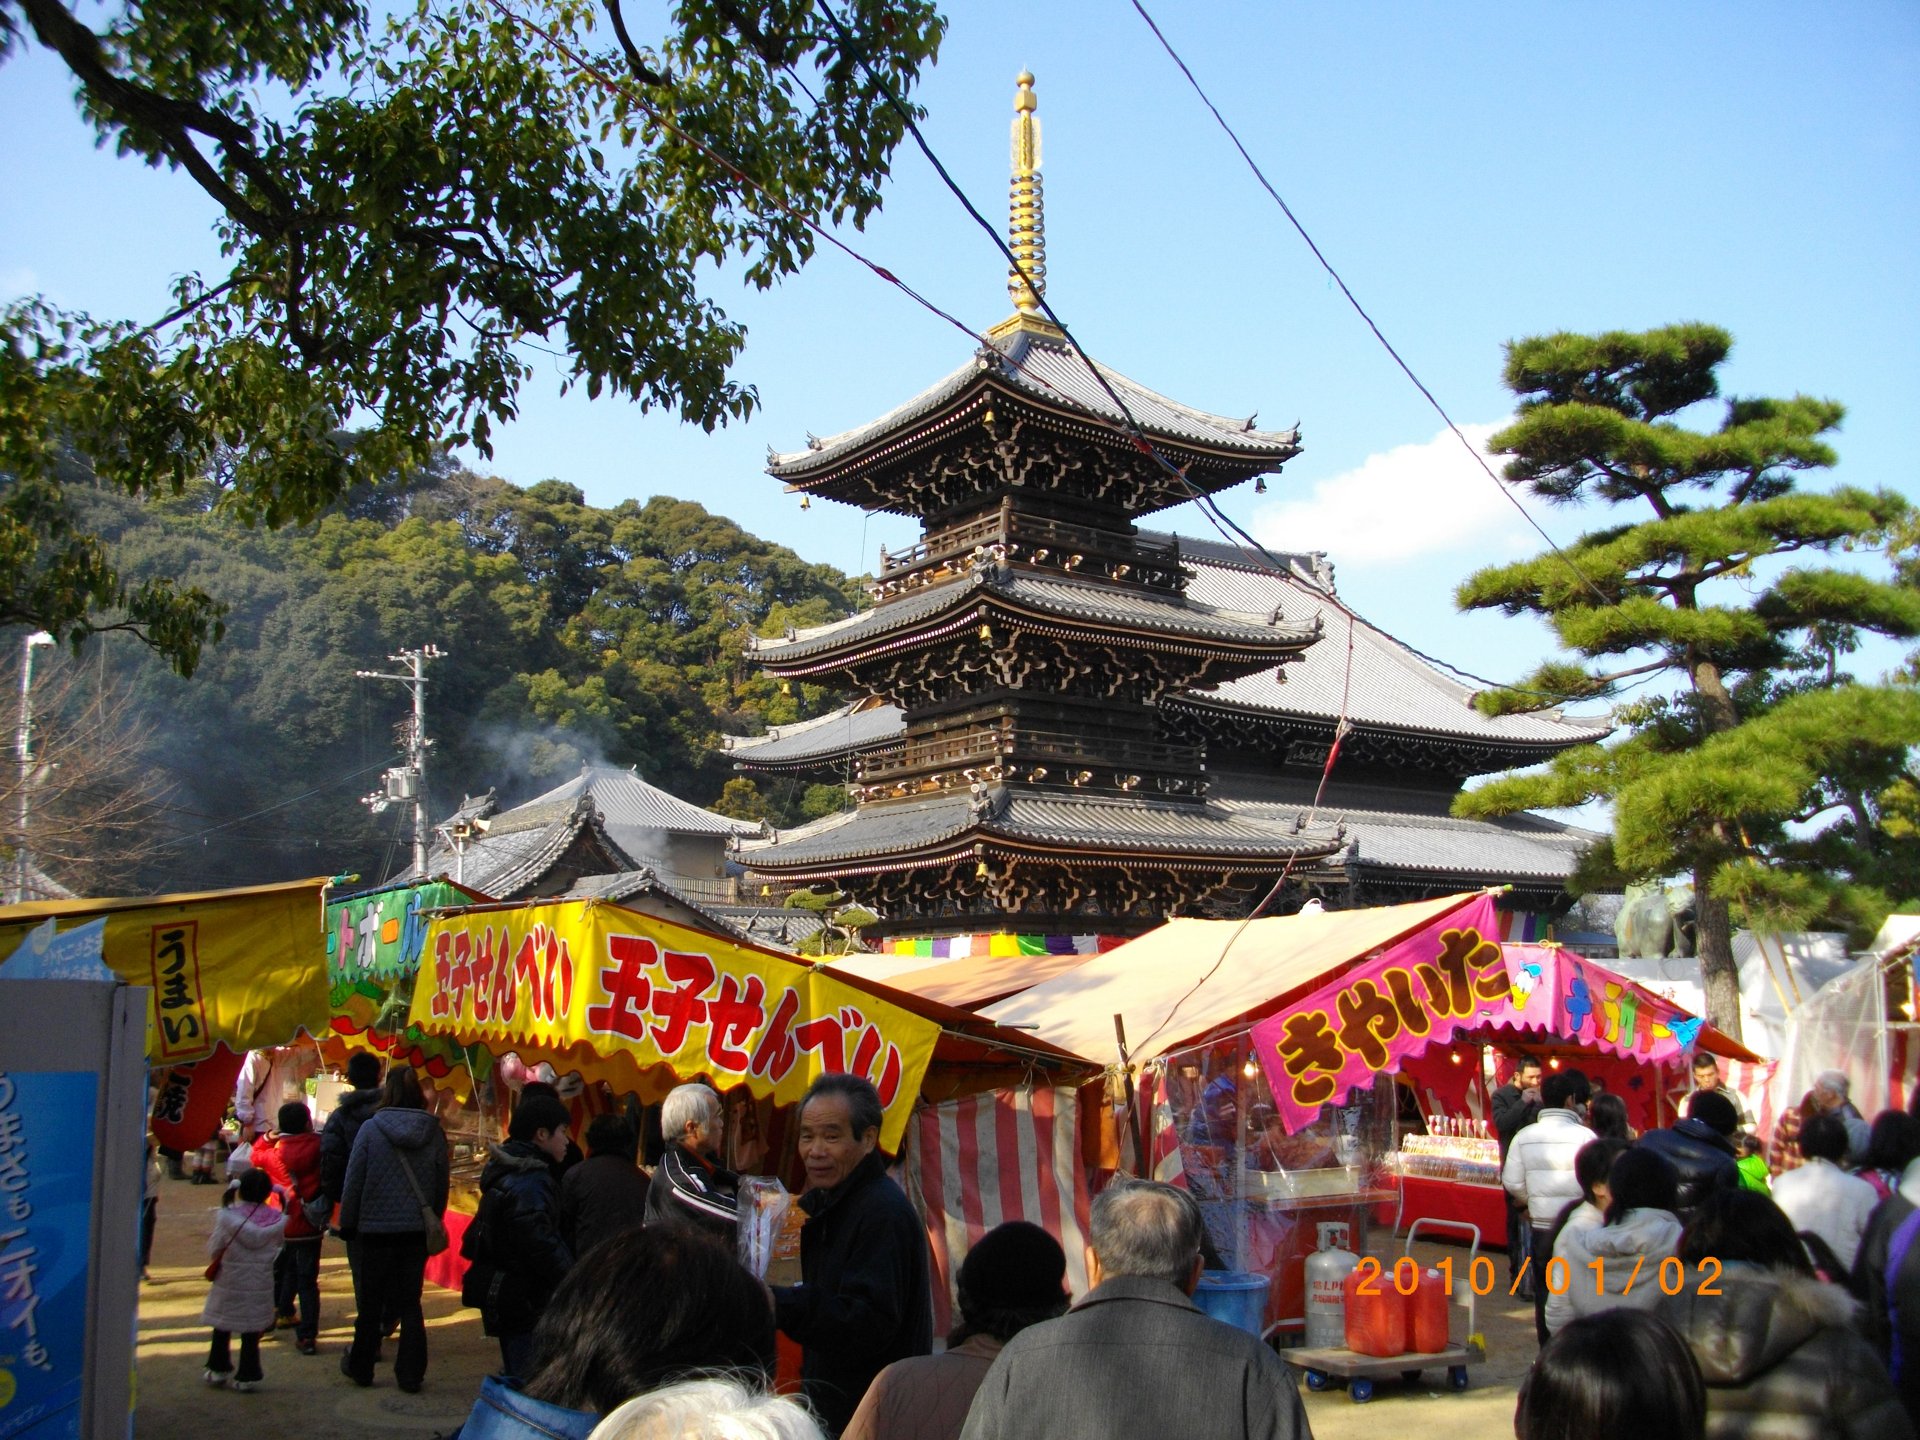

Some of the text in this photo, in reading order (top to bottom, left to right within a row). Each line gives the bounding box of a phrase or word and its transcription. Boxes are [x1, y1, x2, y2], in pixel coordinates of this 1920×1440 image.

[157, 929, 199, 1044] うまい
[431, 922, 573, 1023] 玉子せんべい
[588, 933, 902, 1110] 玉子せんべい
